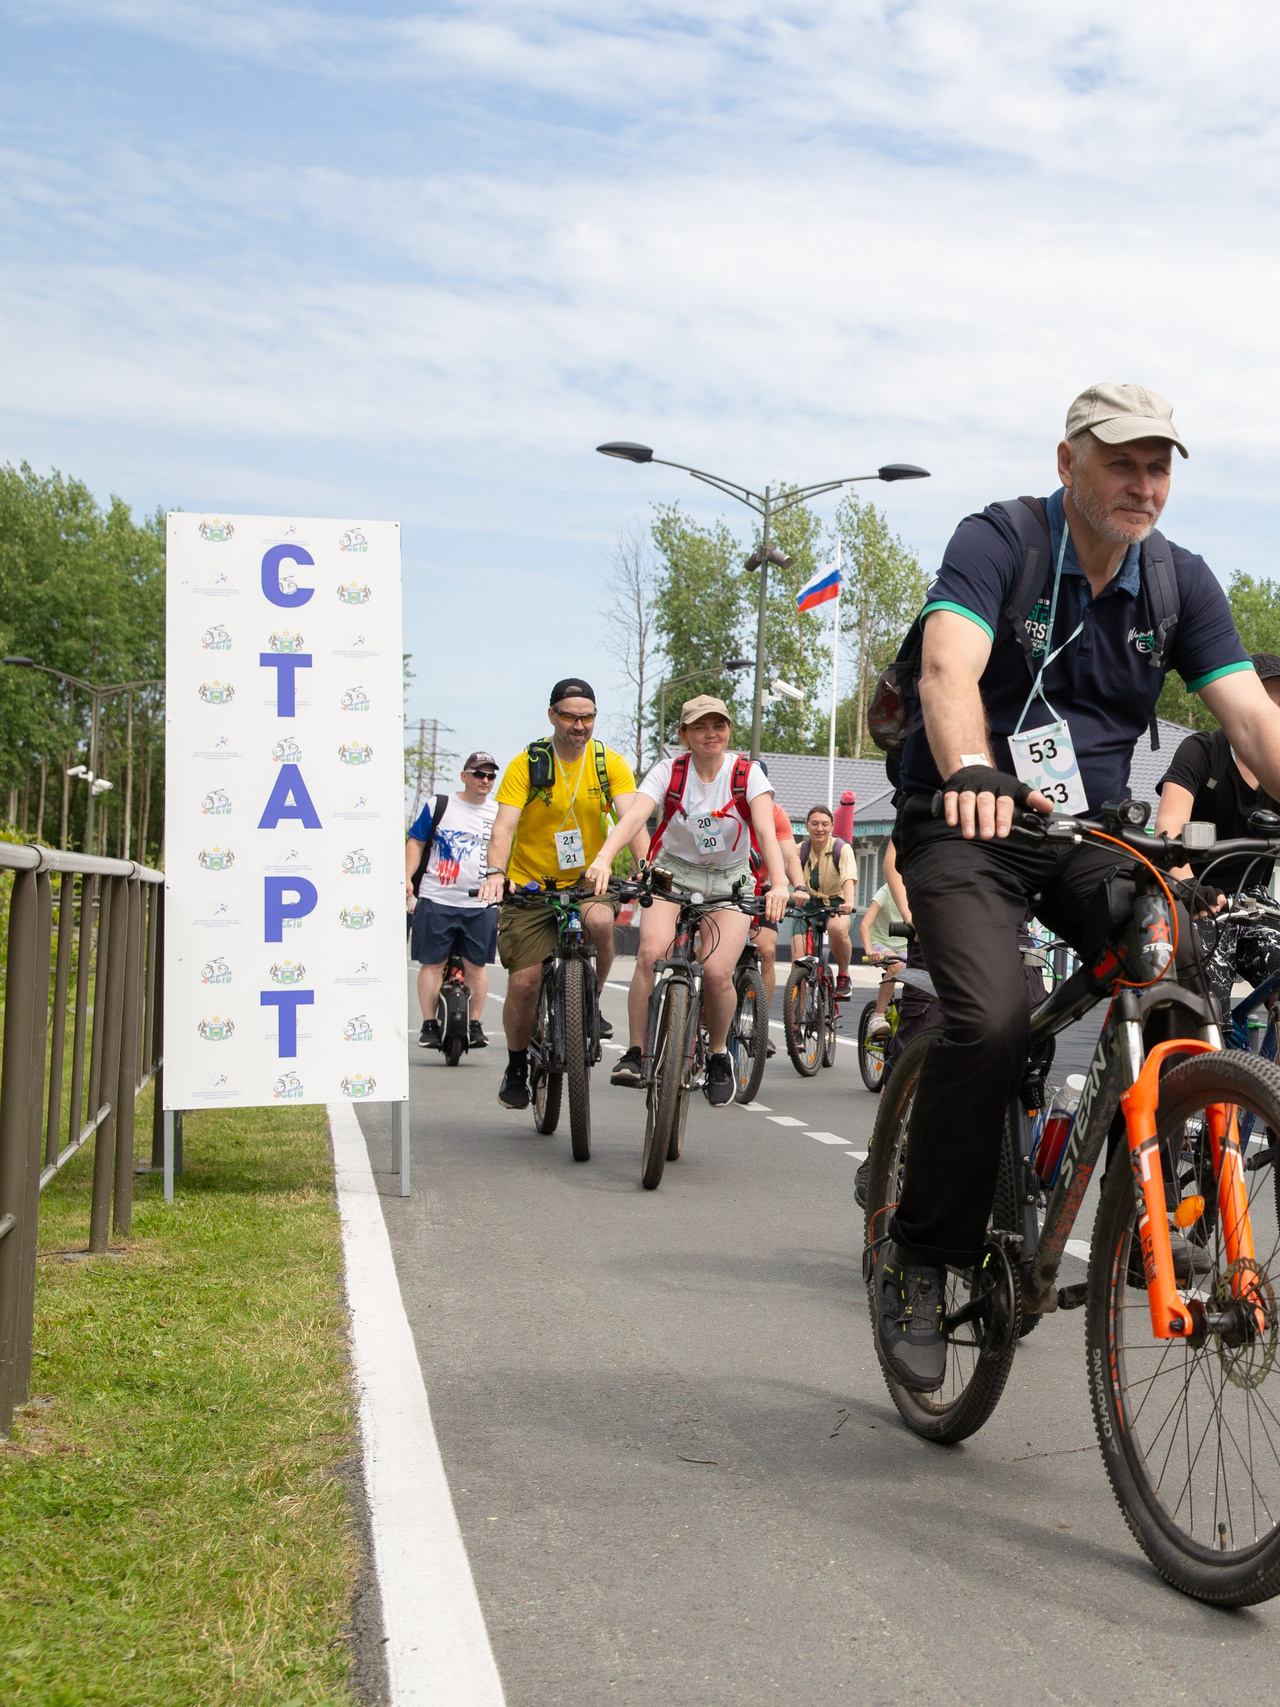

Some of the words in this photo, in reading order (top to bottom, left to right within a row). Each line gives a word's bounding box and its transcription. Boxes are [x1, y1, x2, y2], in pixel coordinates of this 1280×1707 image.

[1028, 738, 1058, 764] 53
[257, 544, 322, 1058] СТАРТ
[1040, 783, 1069, 804] 53
[697, 817, 712, 829] 20
[562, 836, 575, 845] 21
[702, 837, 717, 848] 20
[566, 854, 578, 863] 21
[1060, 1042, 1108, 1189] STERN
[1092, 1348, 1114, 1440] CHAOYANG
